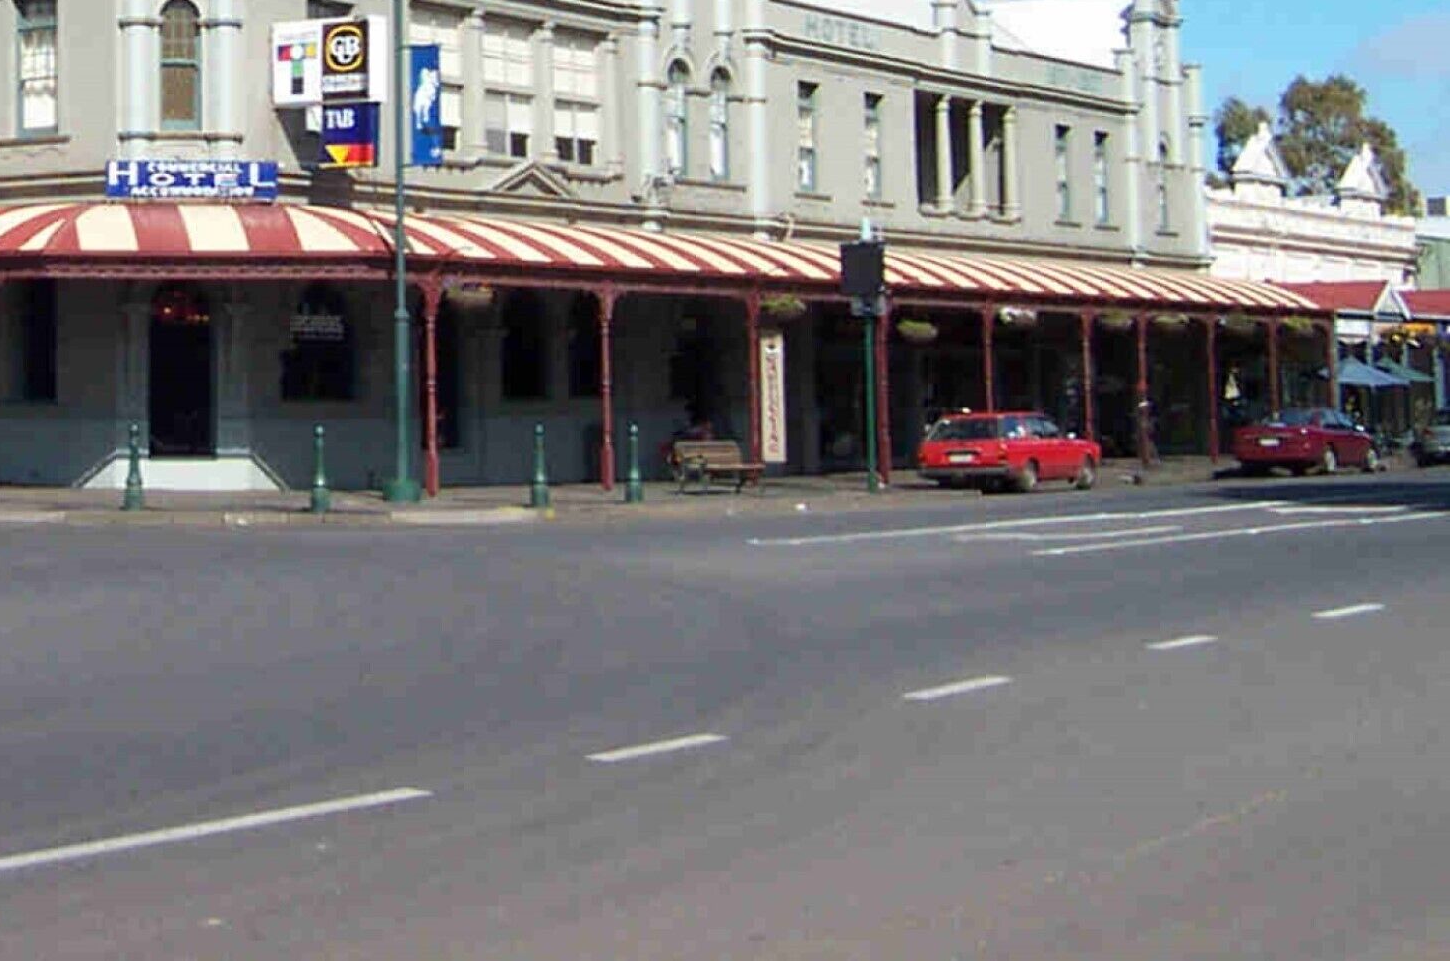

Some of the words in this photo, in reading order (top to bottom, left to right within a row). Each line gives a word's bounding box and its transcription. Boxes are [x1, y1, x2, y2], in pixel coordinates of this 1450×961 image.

[803, 13, 874, 49] HOTEL
[325, 108, 355, 129] TAB
[108, 161, 276, 187] HOTEL
